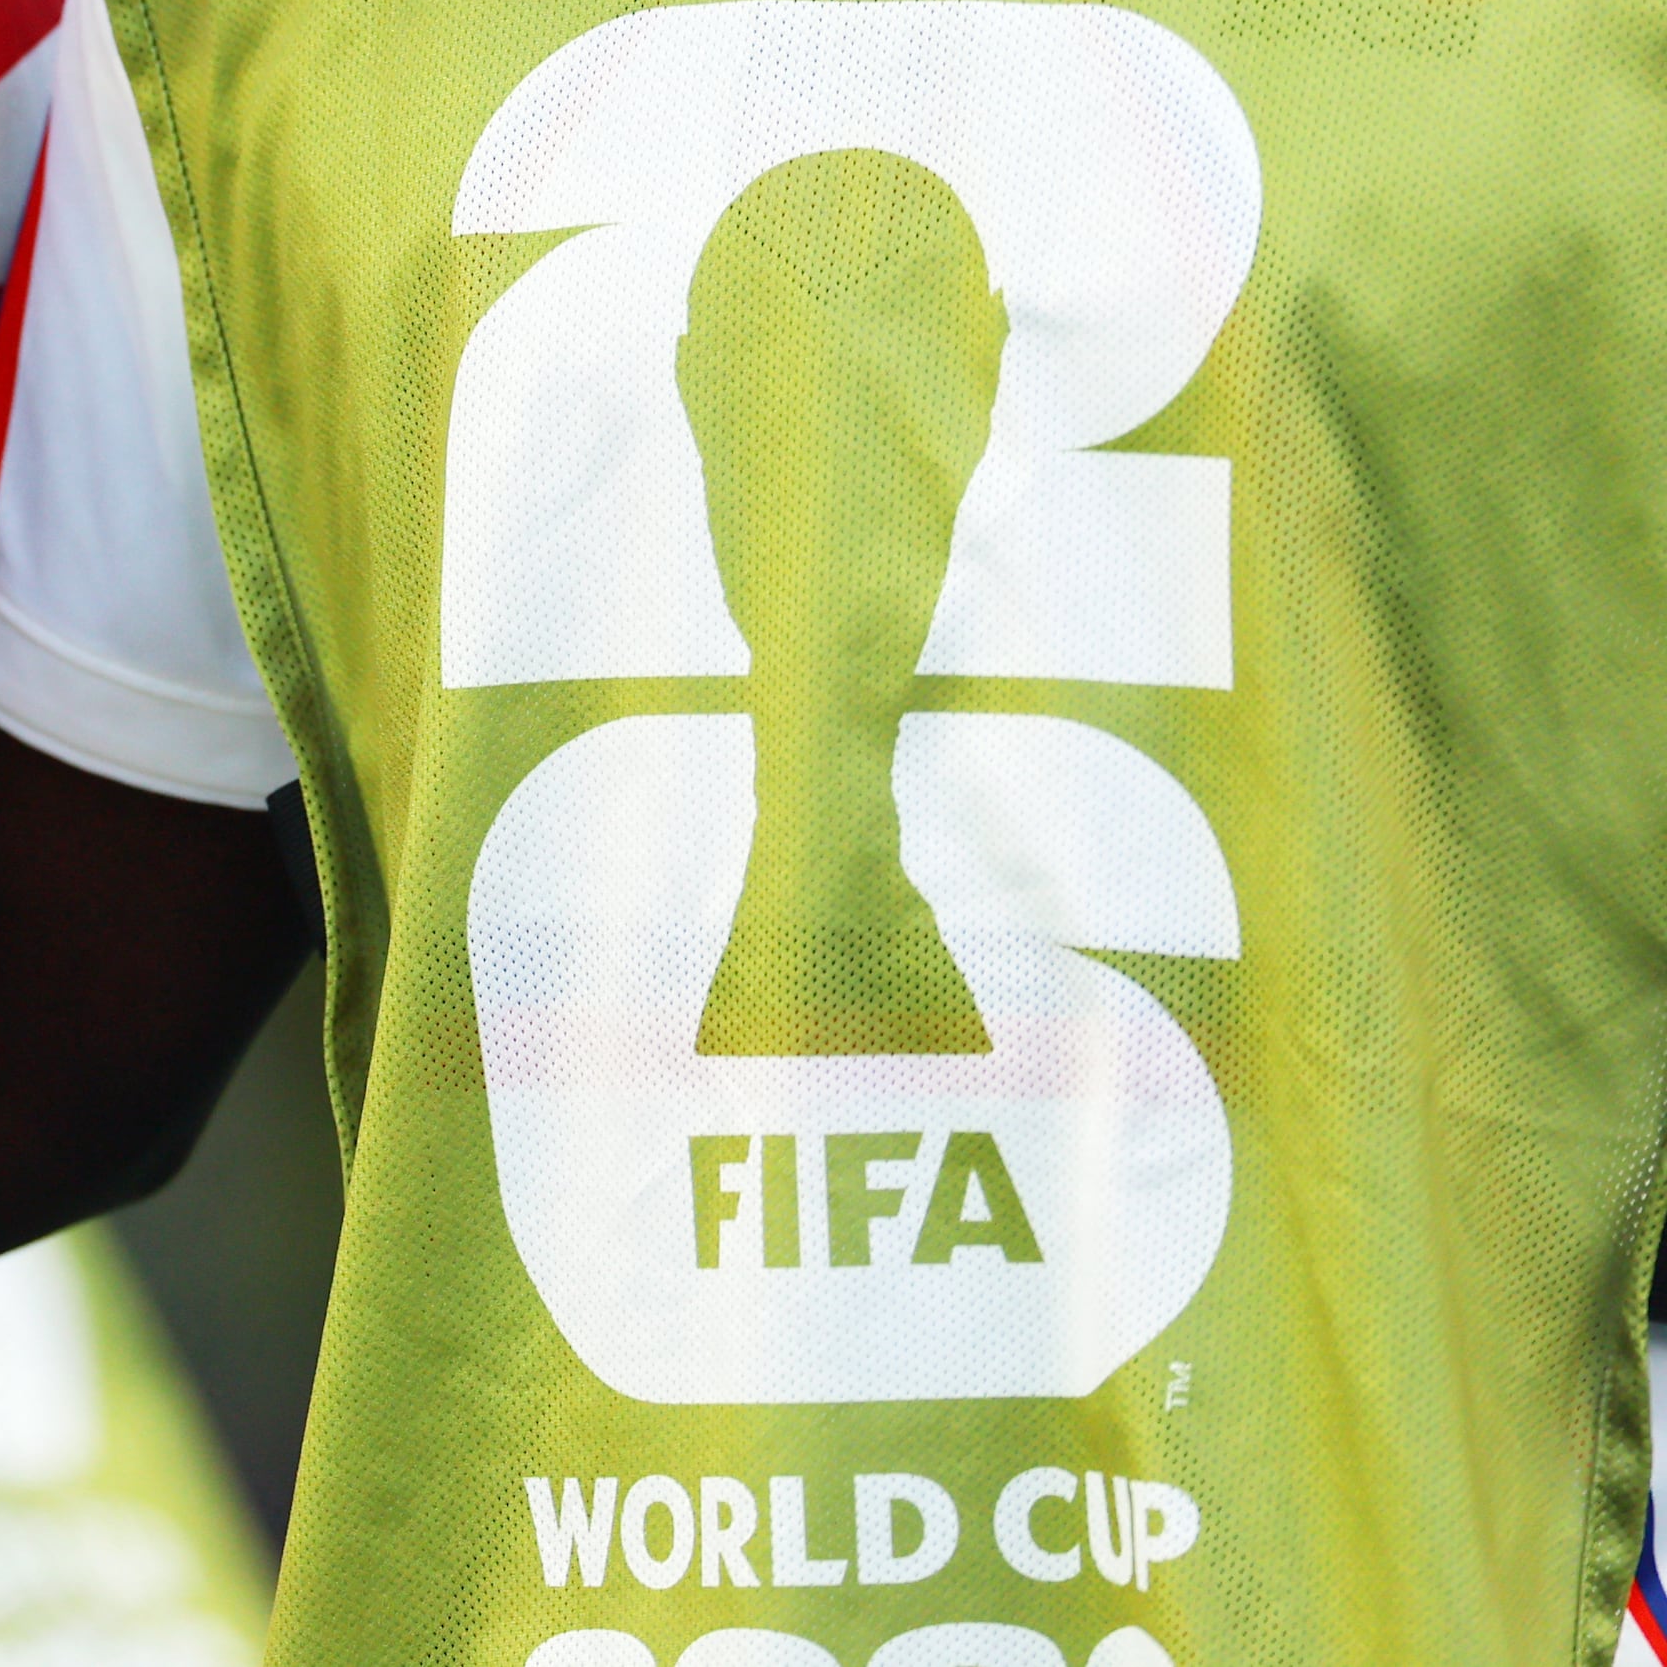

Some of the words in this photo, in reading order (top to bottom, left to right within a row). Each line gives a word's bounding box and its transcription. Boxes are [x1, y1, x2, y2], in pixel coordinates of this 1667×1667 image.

[689, 1131, 1044, 1269] FIFA
[523, 1471, 960, 1590] WORLD
[993, 1465, 1202, 1593] CUP
